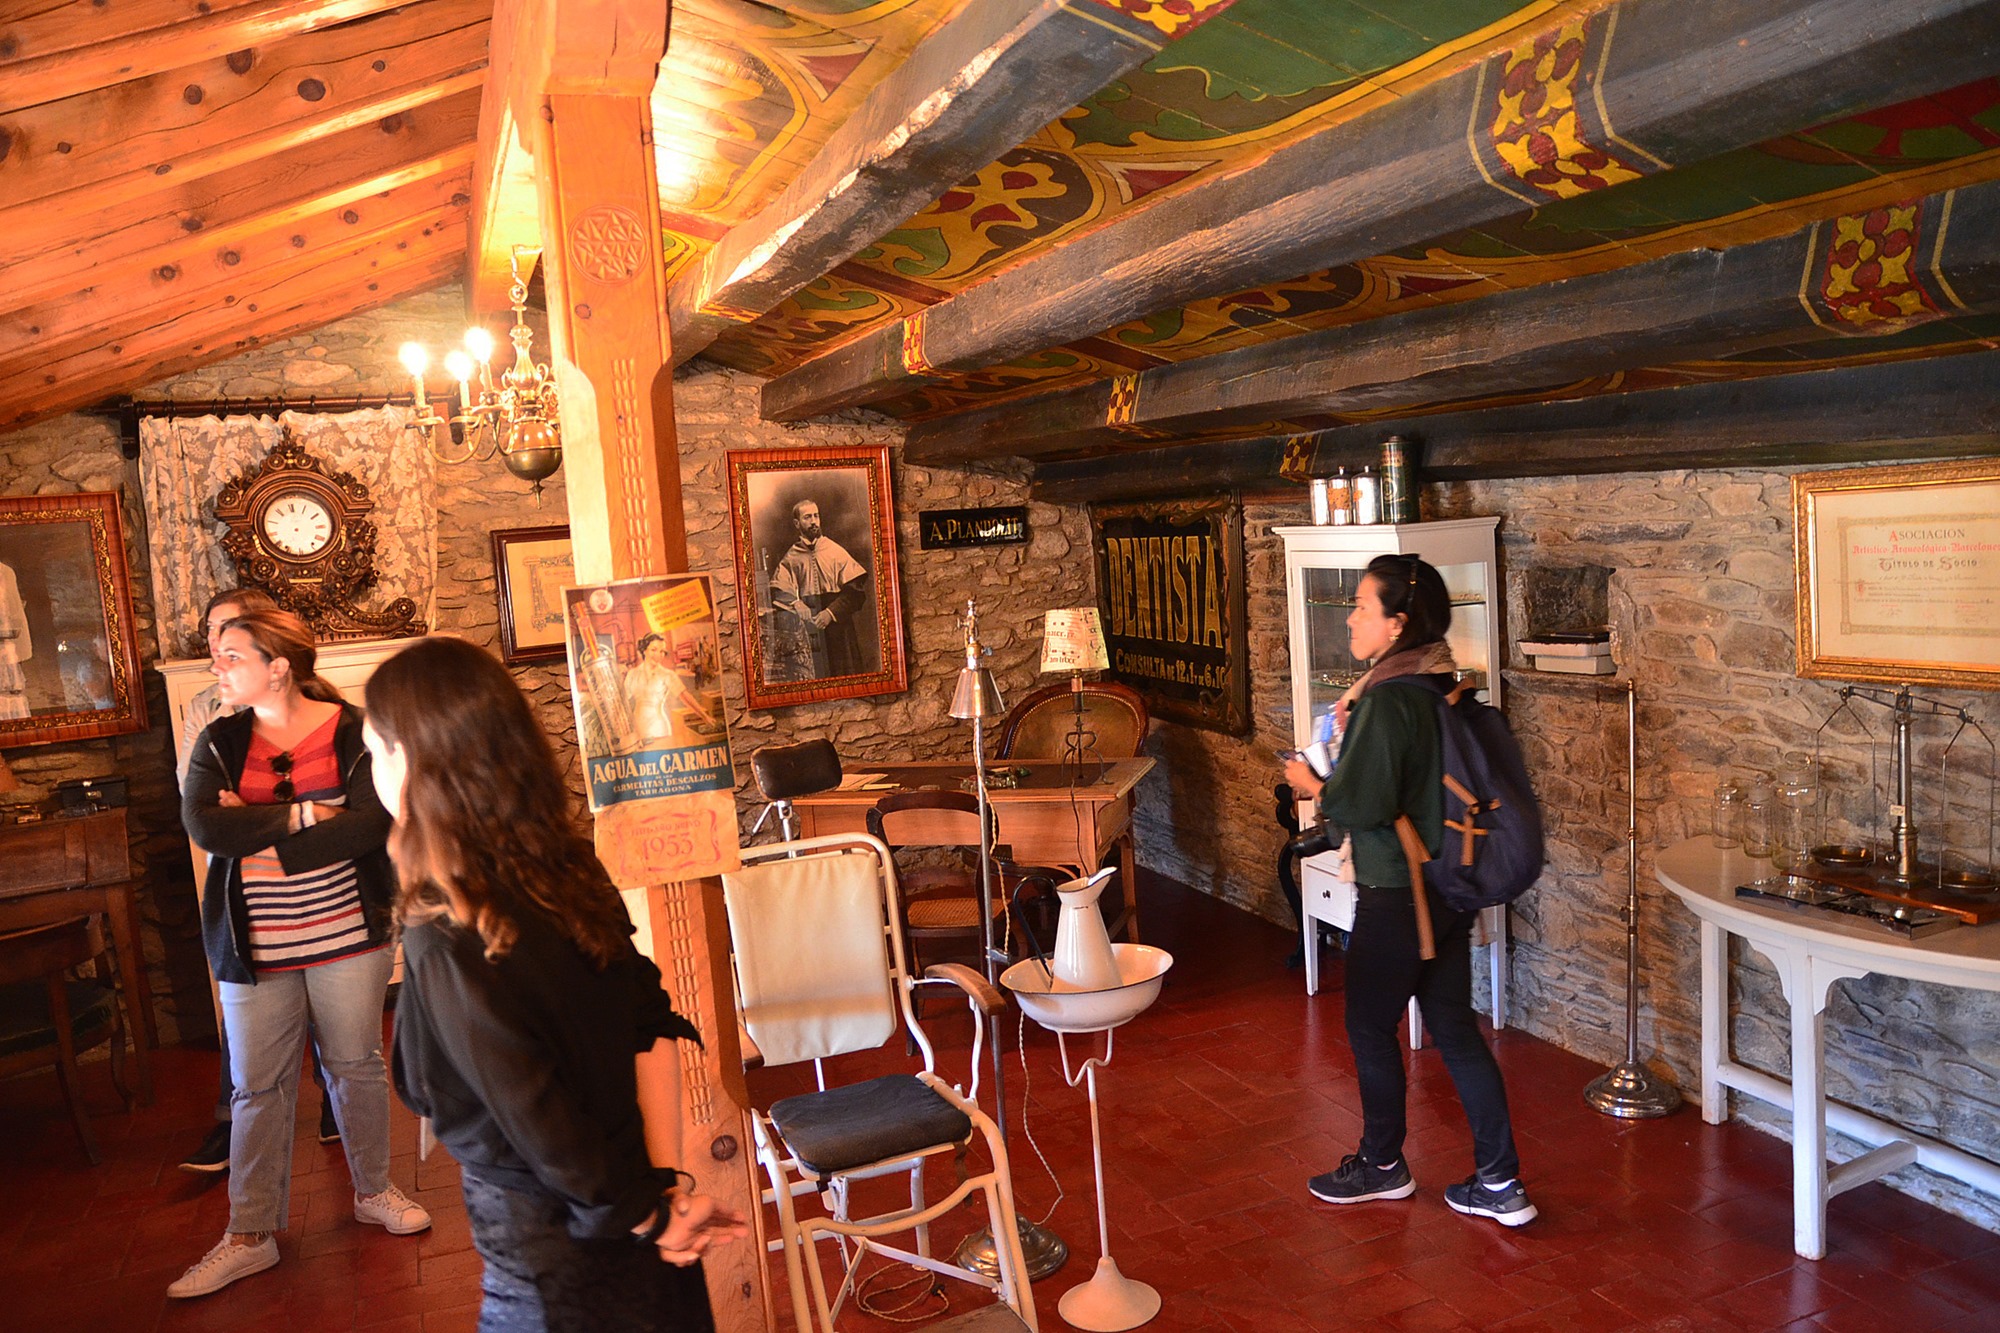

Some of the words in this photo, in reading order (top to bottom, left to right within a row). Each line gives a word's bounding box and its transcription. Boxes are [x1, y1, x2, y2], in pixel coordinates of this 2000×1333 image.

[1106, 535, 1223, 649] DENTISTA
[1116, 648, 1166, 679] CONSULTA
[593, 758, 639, 784] AGUA
[639, 762, 660, 776] DEL
[659, 746, 728, 774] CARMEN
[613, 779, 667, 793] CARMELITAS
[666, 773, 717, 786] DESCALZOS
[635, 785, 691, 796] TARRAGONA
[643, 832, 694, 860] 1953
